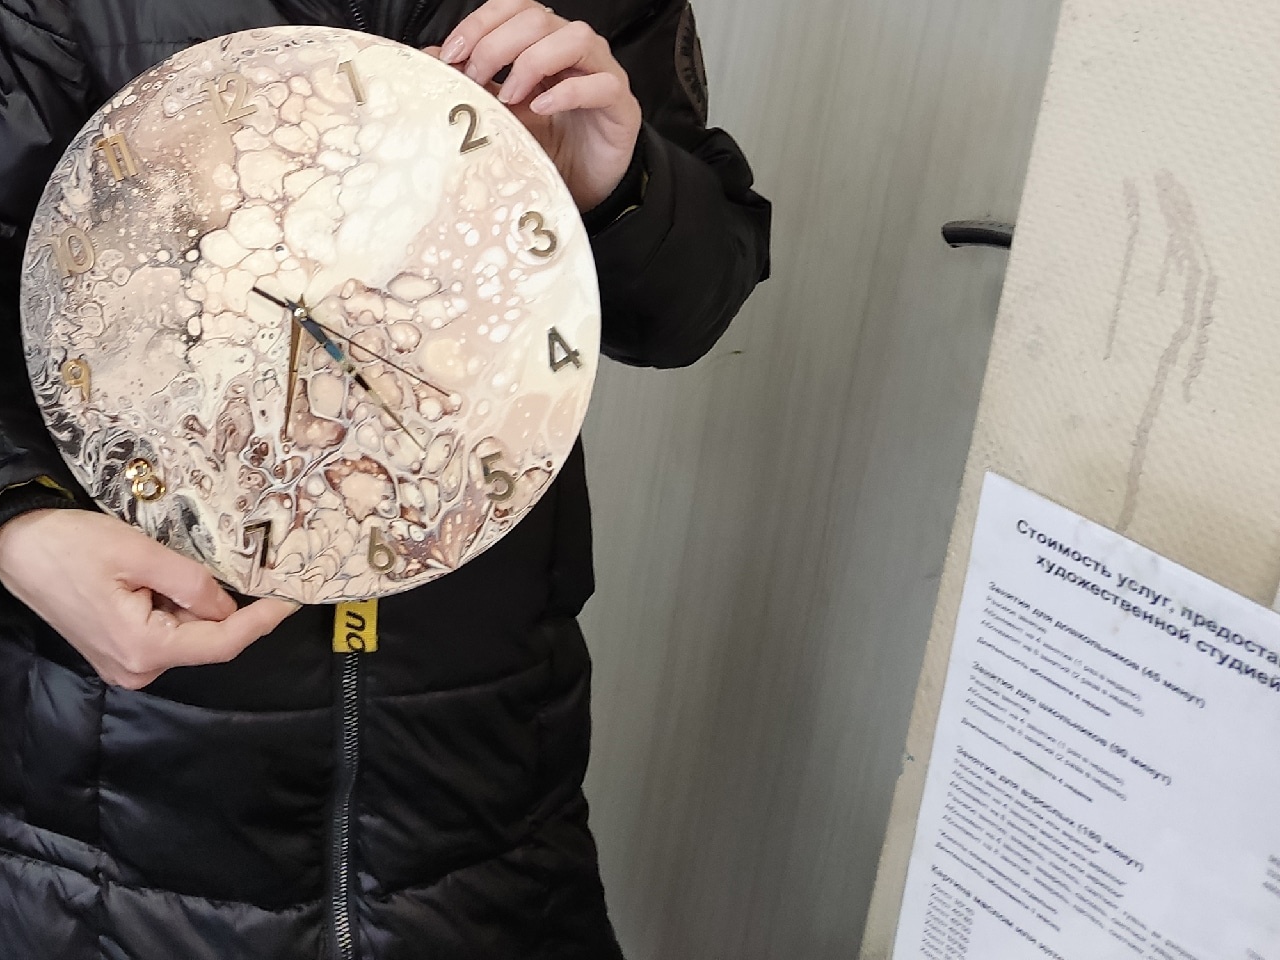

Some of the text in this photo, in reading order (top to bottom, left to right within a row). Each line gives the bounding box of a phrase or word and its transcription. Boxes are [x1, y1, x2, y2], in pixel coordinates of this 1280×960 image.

[211, 71, 259, 126] 12
[335, 58, 368, 107] 1
[447, 102, 490, 154] 2
[94, 132, 141, 182] 11
[48, 224, 95, 279] 10
[517, 210, 559, 260] 3
[546, 324, 584, 376] 4
[60, 357, 93, 402] 9
[125, 457, 166, 503] 8
[480, 450, 516, 503] 5
[242, 519, 275, 571] 7
[365, 526, 399, 575] 6
[1016, 519, 1113, 578] Стоимость
[1180, 605, 1280, 669] предоста
[1035, 554, 1191, 644] художественной
